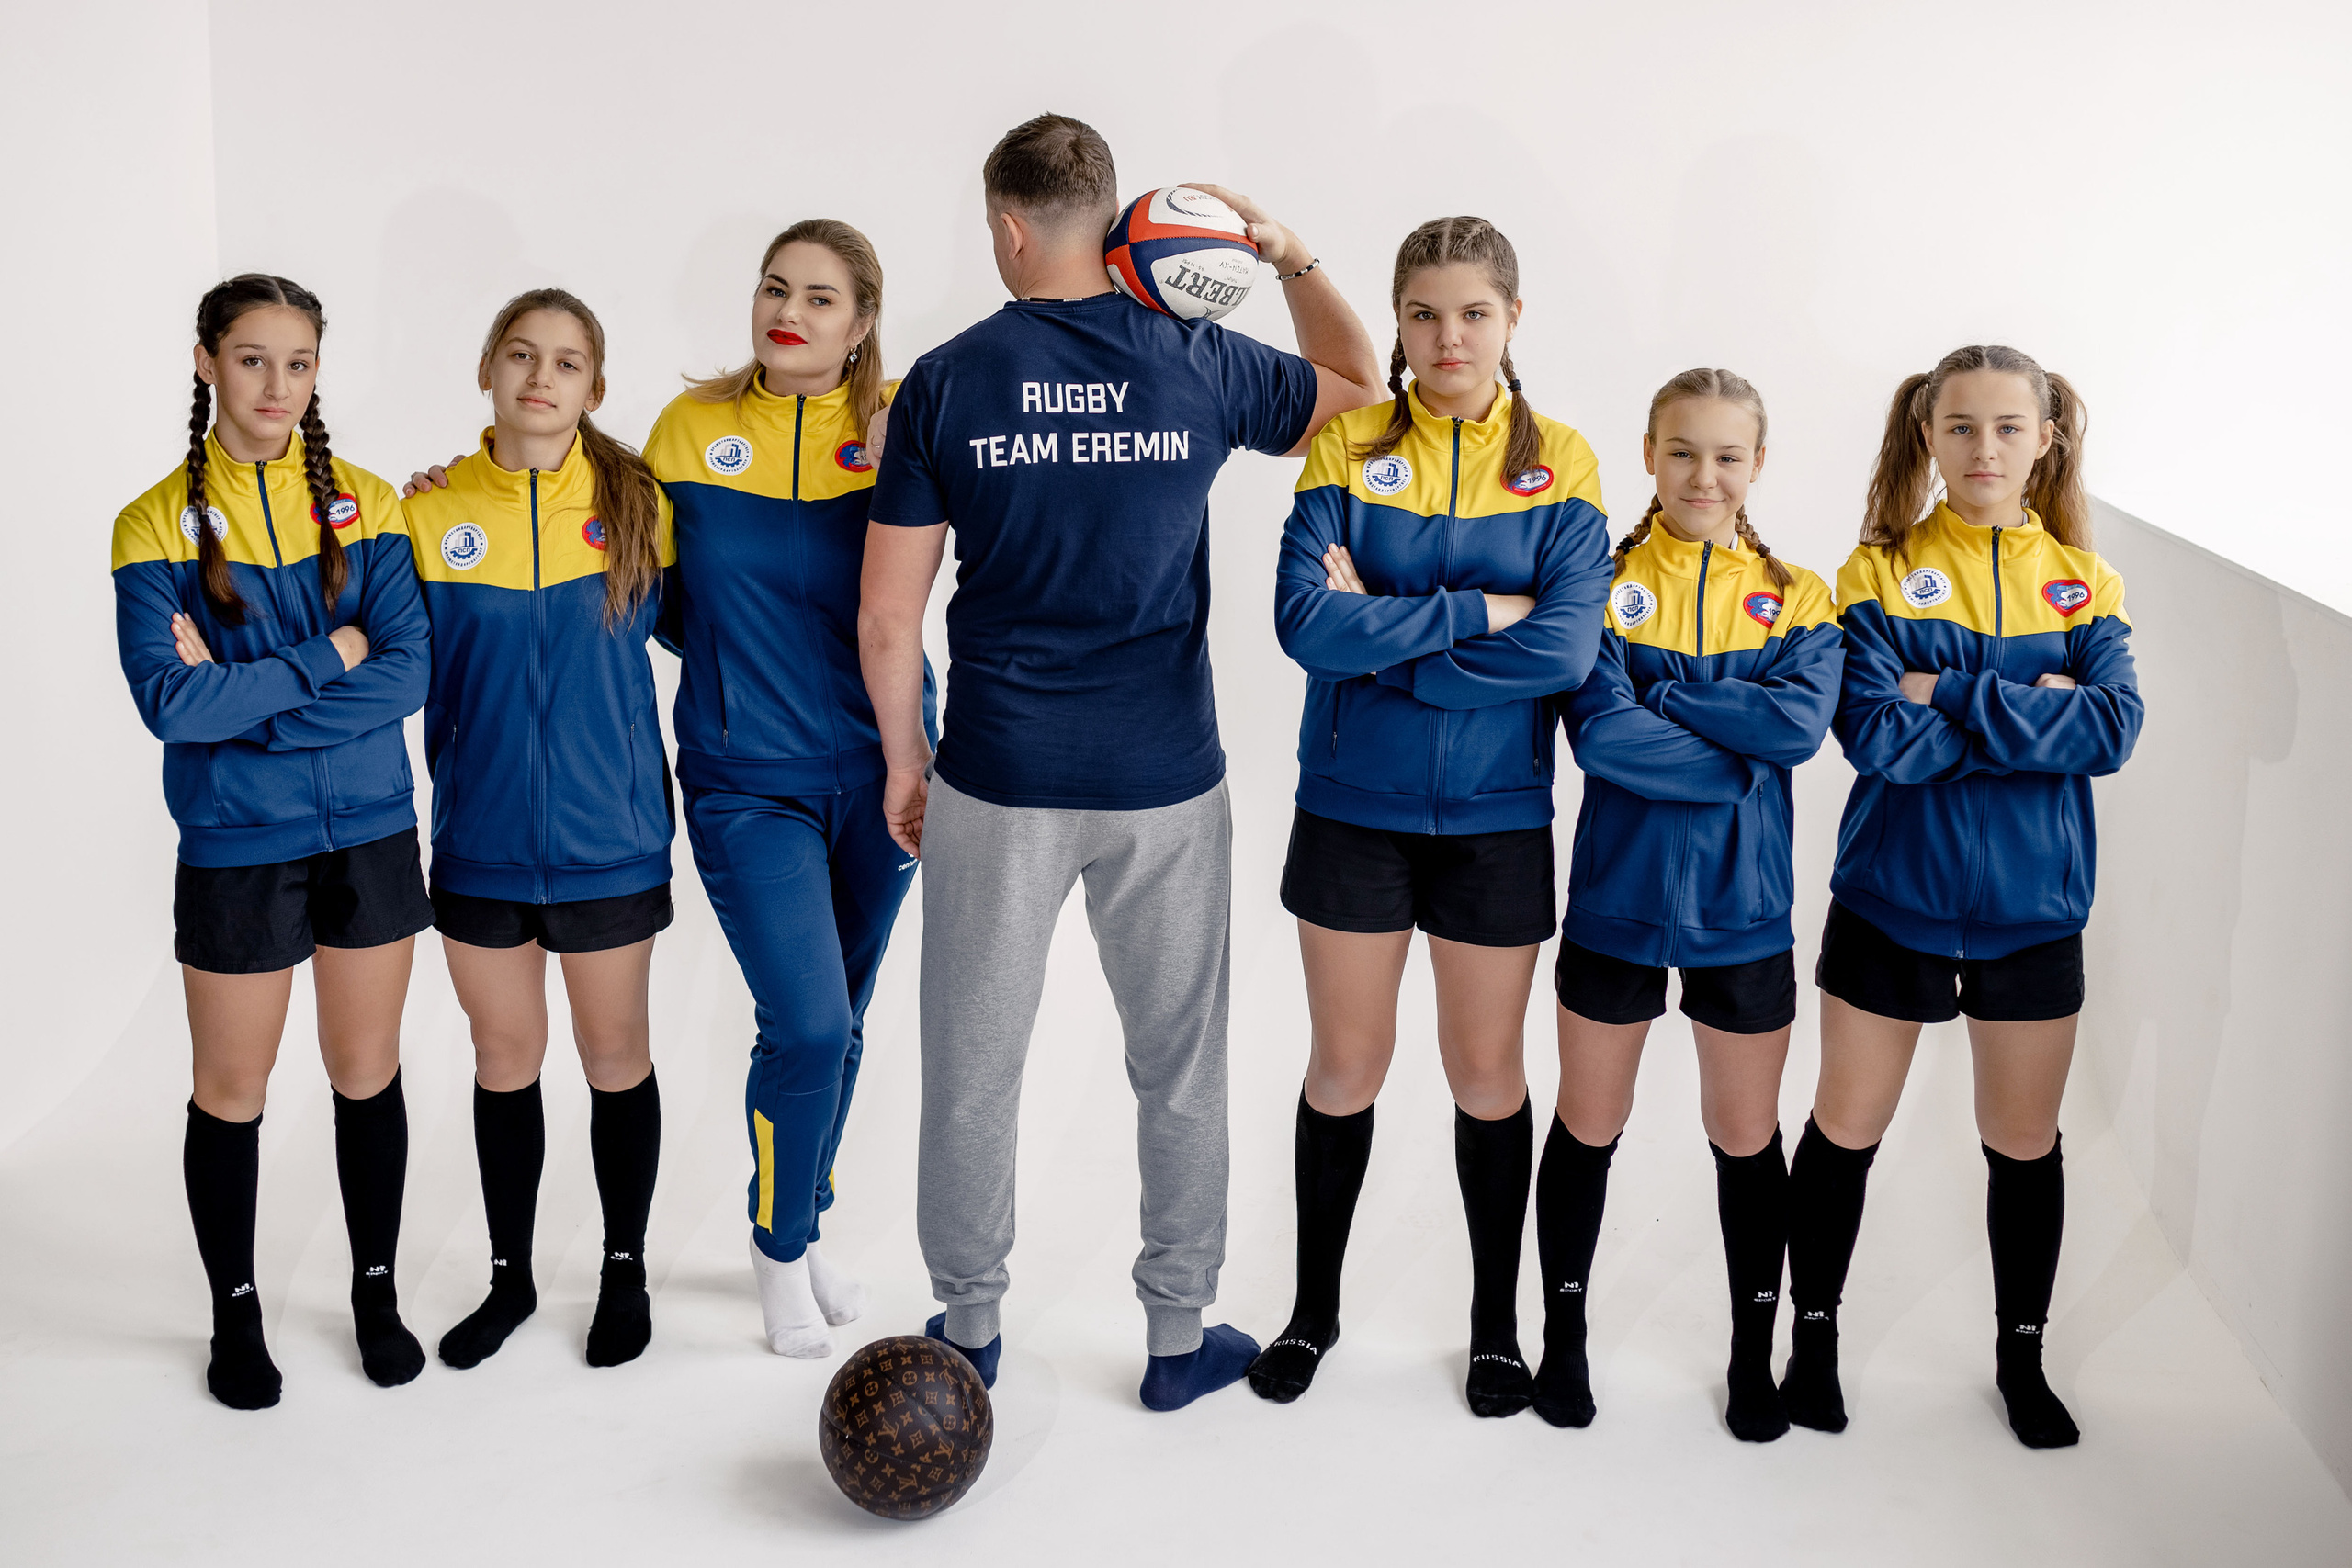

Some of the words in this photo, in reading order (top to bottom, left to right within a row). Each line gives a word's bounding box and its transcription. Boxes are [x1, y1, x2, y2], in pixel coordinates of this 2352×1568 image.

[1022, 381, 1129, 413] RUGBY
[969, 432, 1058, 469] TEAM
[1072, 430, 1189, 463] EREMIN
[1527, 475, 1547, 484] 1996
[336, 504, 356, 515] 1996
[2067, 591, 2085, 602] 1996
[1769, 608, 1781, 616] 199
[1273, 1338, 1318, 1356] RUSSIA
[1472, 1353, 1521, 1368] RUSSIA
